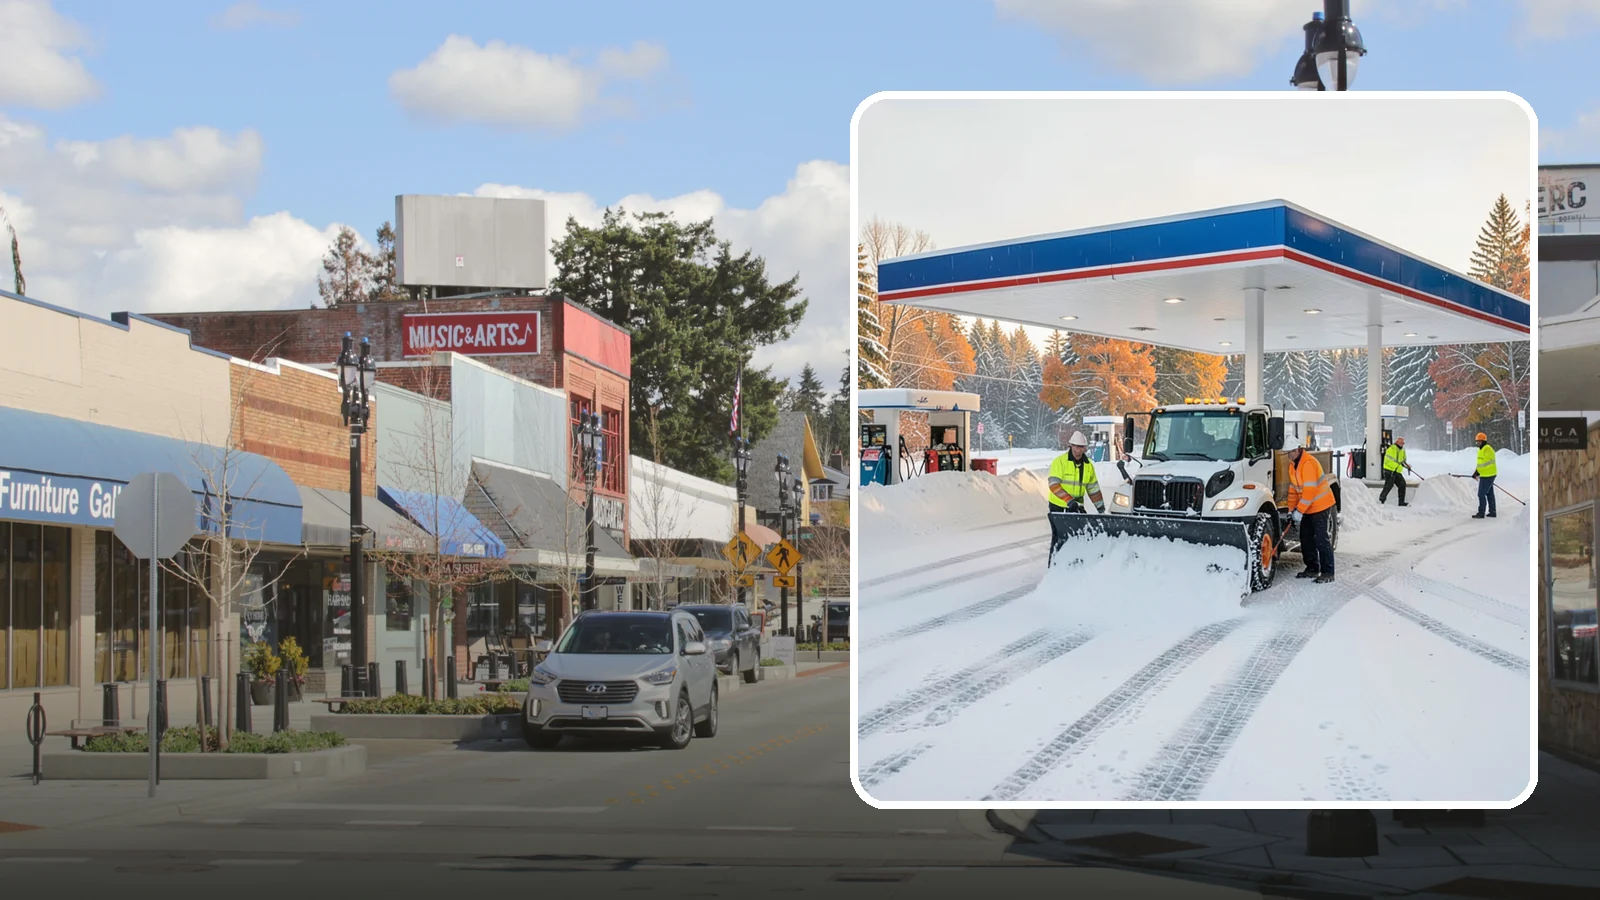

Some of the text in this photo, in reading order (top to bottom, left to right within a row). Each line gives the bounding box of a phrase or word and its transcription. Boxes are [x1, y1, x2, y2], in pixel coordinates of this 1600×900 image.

[1540, 427, 1577, 436] UGA
[0, 471, 122, 519] Furniture Gal
[453, 563, 479, 574] SUSHI
